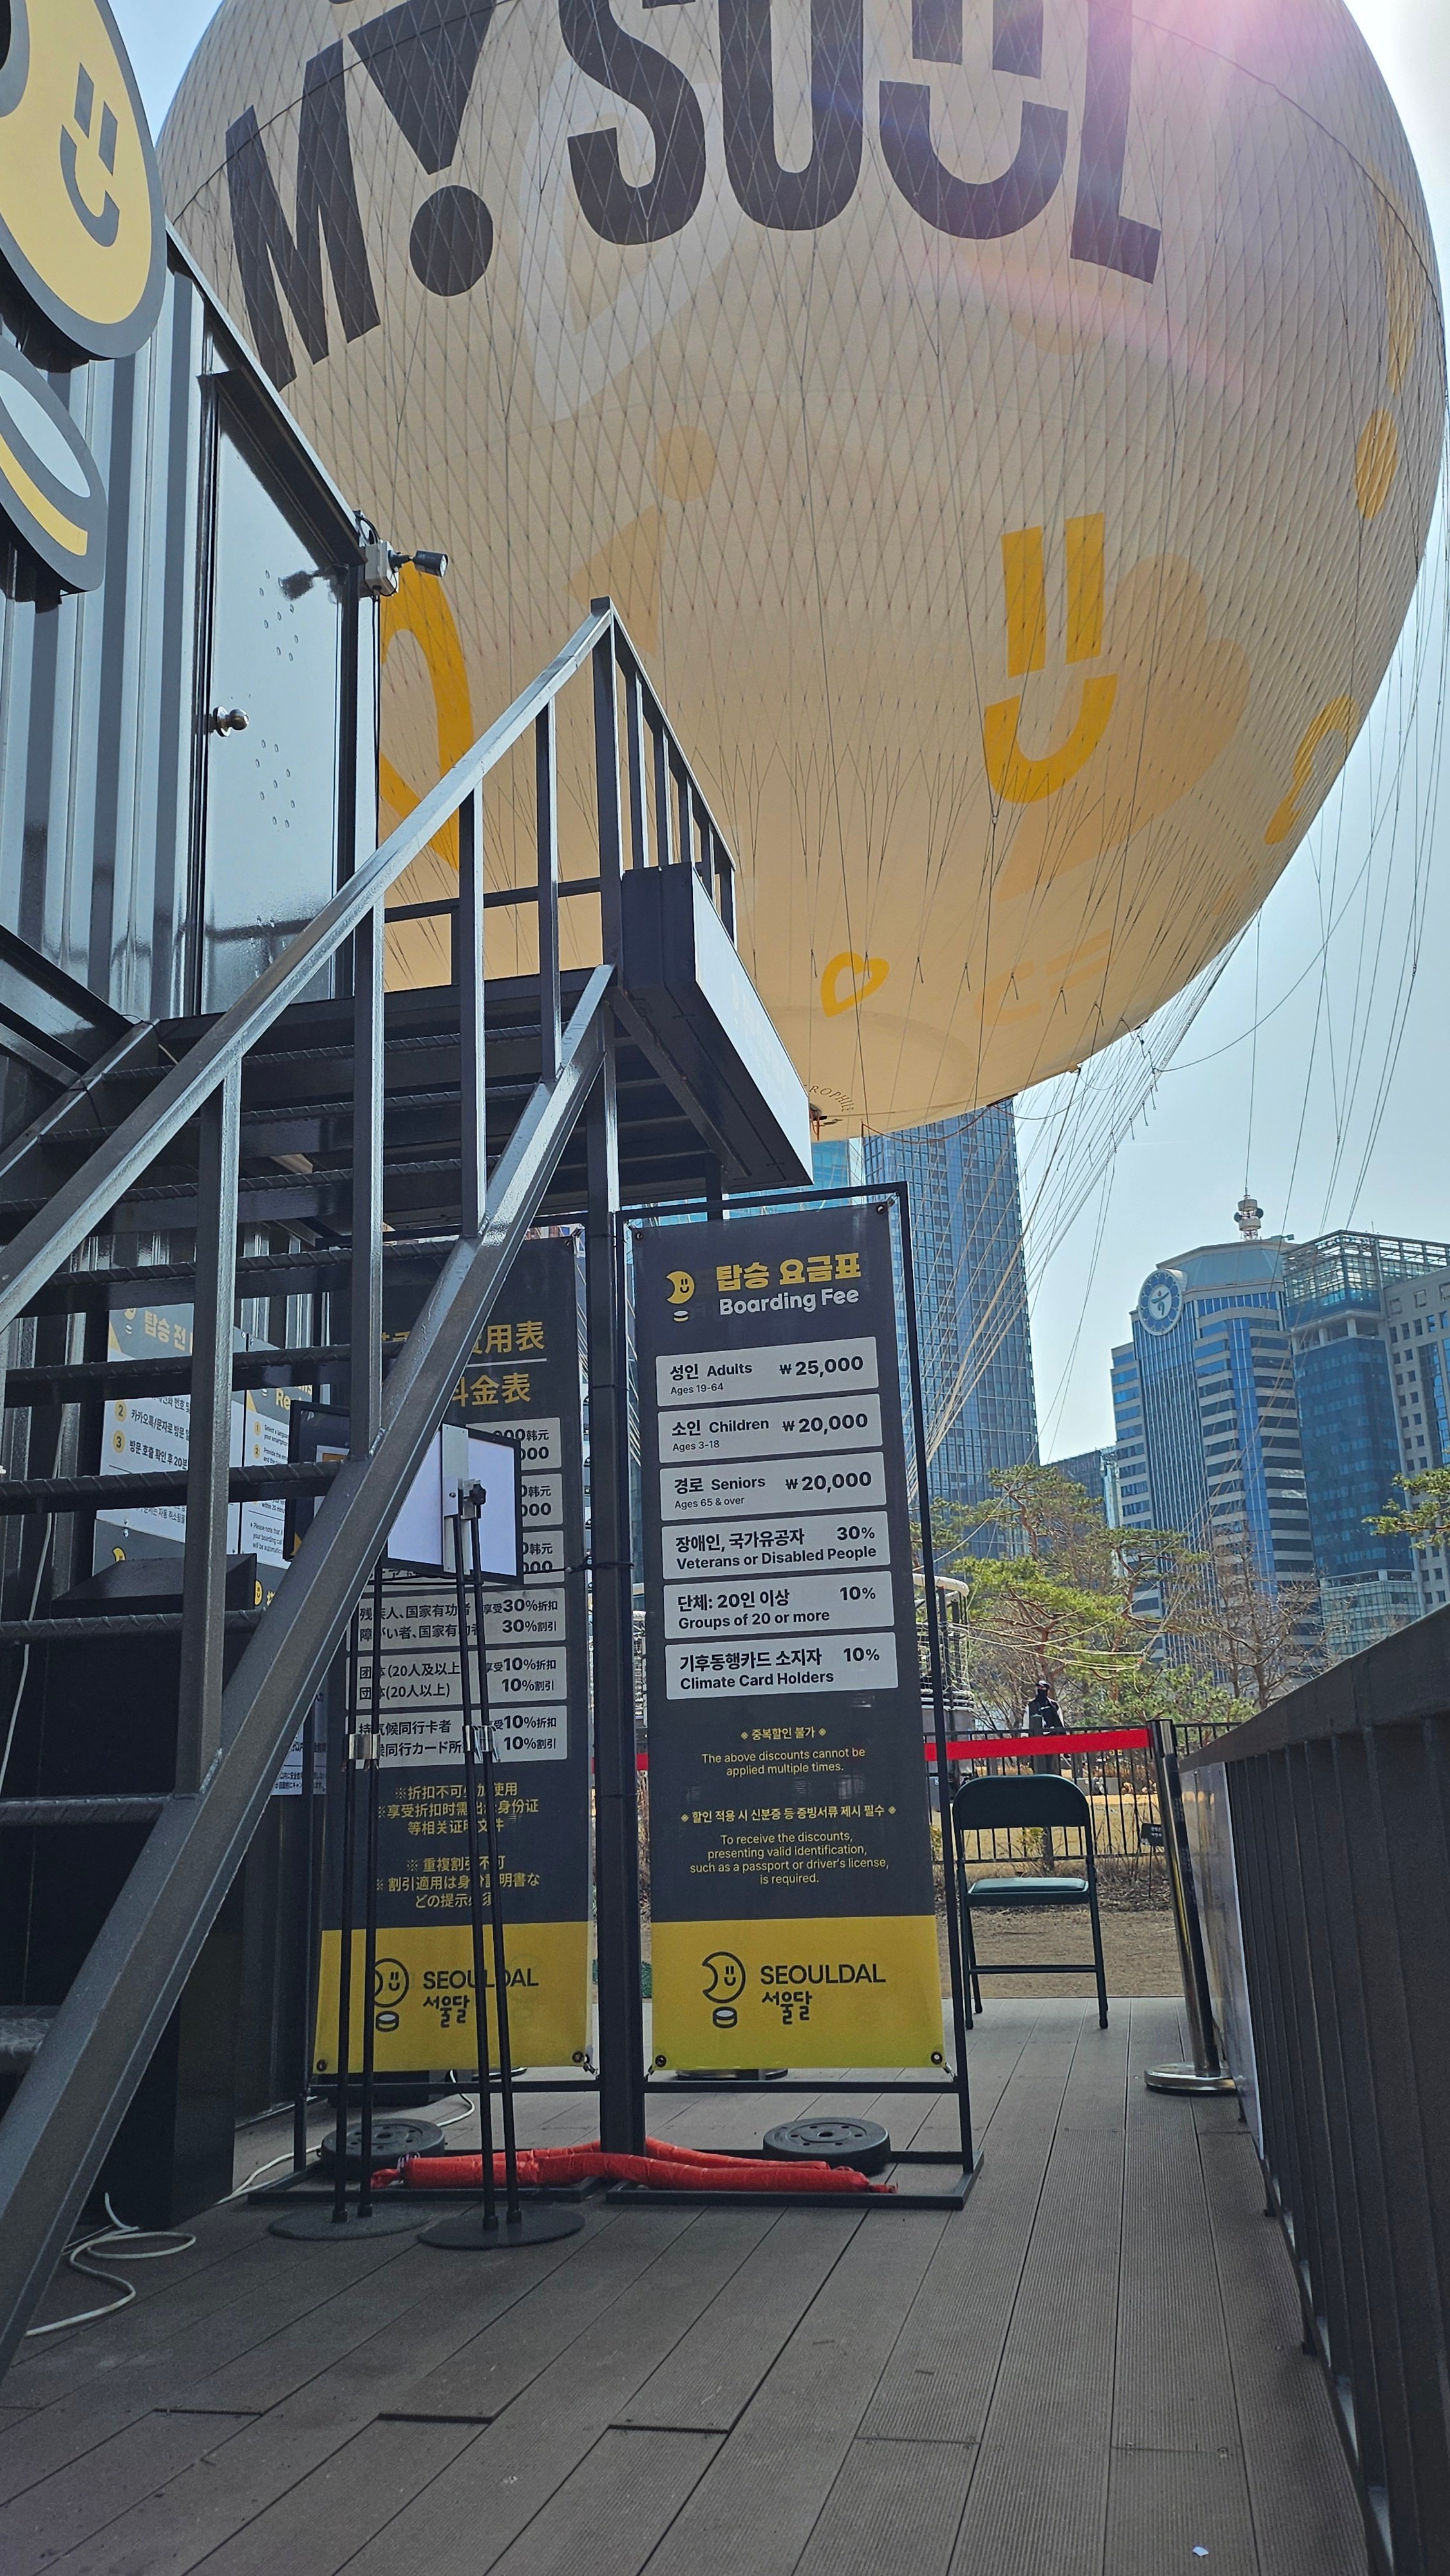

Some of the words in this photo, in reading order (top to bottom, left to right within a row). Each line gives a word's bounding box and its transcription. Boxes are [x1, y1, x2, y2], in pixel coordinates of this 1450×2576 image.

[804, 1084, 854, 1113] ROPHILE
[716, 1262, 769, 1292] 탑승
[779, 1253, 862, 1285] 요금표
[719, 1292, 816, 1316] Boarding
[822, 1287, 859, 1306] Fee
[145, 1310, 170, 1343] 탑승
[473, 1320, 545, 1354] 用表
[670, 1363, 699, 1381] 성인
[707, 1363, 752, 1378] Adults
[670, 1385, 694, 1395] Ages
[696, 1383, 724, 1393] 19-64
[118, 1405, 123, 1417] 2
[671, 1420, 701, 1437] 소인
[709, 1419, 769, 1434] Children
[117, 1436, 121, 1448] 3
[130, 1440, 141, 1454] 방문
[168, 1454, 173, 1464] 후
[672, 1442, 697, 1453] Ages
[699, 1440, 720, 1450] 3-18
[674, 1477, 704, 1495] 경로
[711, 1477, 766, 1491] Seniors
[674, 1499, 699, 1510] Ages
[701, 1499, 713, 1507] 65
[724, 1497, 745, 1506] over
[675, 1534, 726, 1553] 장애인,
[728, 1528, 805, 1549] 국가유공자
[836, 1526, 875, 1541] 30%
[677, 1553, 740, 1570] Veterans
[744, 1555, 758, 1567] or
[762, 1549, 824, 1564] Disabled
[827, 1546, 876, 1563] People
[677, 1593, 713, 1612] 단체:
[717, 1591, 755, 1609] 20인
[759, 1589, 790, 1606] 이상
[840, 1586, 876, 1601] 10%
[502, 1619, 556, 1633] 30%割引
[678, 1616, 731, 1631] Groups
[734, 1615, 748, 1626] of
[751, 1613, 771, 1625] 20
[774, 1613, 789, 1624] or
[793, 1611, 830, 1623] more
[679, 1651, 771, 1672] 기후동행카드
[776, 1648, 822, 1667] 소지자
[843, 1647, 880, 1662] 10%
[502, 1678, 554, 1692] 10%割引
[681, 1676, 735, 1690] Climate
[739, 1674, 773, 1687] Card
[777, 1671, 834, 1685] Holders
[490, 1715, 556, 1730] 受10%折扣
[751, 1727, 792, 1740] 중복할인
[795, 1727, 815, 1739] 불가
[504, 1736, 556, 1750] 10%割引
[702, 1754, 721, 1764] The
[724, 1752, 756, 1763] above
[758, 1750, 809, 1761] discounts
[812, 1748, 849, 1759] cannot
[852, 1747, 865, 1757] be
[726, 1765, 765, 1777] applied
[767, 1763, 809, 1775] multiple
[811, 1761, 844, 1772] times.
[692, 1811, 712, 1823] 할인
[715, 1810, 735, 1822] 적용
[738, 1810, 748, 1821] 시
[751, 1808, 781, 1821] 신분증
[784, 1808, 794, 1820] 등
[796, 1806, 838, 1819] 증빙서류
[840, 1806, 861, 1817] 제시
[863, 1804, 885, 1817] 필수
[720, 1835, 733, 1845] To
[736, 1833, 775, 1844] receive
[778, 1833, 796, 1842] the
[798, 1832, 853, 1843] discounts,
[708, 1848, 764, 1861] presenting
[767, 1846, 791, 1857] valid
[794, 1844, 867, 1857] identification,
[690, 1862, 715, 1873] such
[718, 1864, 731, 1872] as
[733, 1864, 740, 1872] a
[742, 1861, 789, 1873] passport
[792, 1861, 804, 1870] or
[806, 1858, 845, 1870] driver's
[848, 1857, 889, 1870] license,
[760, 1874, 768, 1884] is
[771, 1873, 819, 1886] required.
[761, 1964, 886, 1985] SEOULDAL
[423, 1994, 470, 2028] 서울달
[762, 1991, 813, 2025] 서울달
